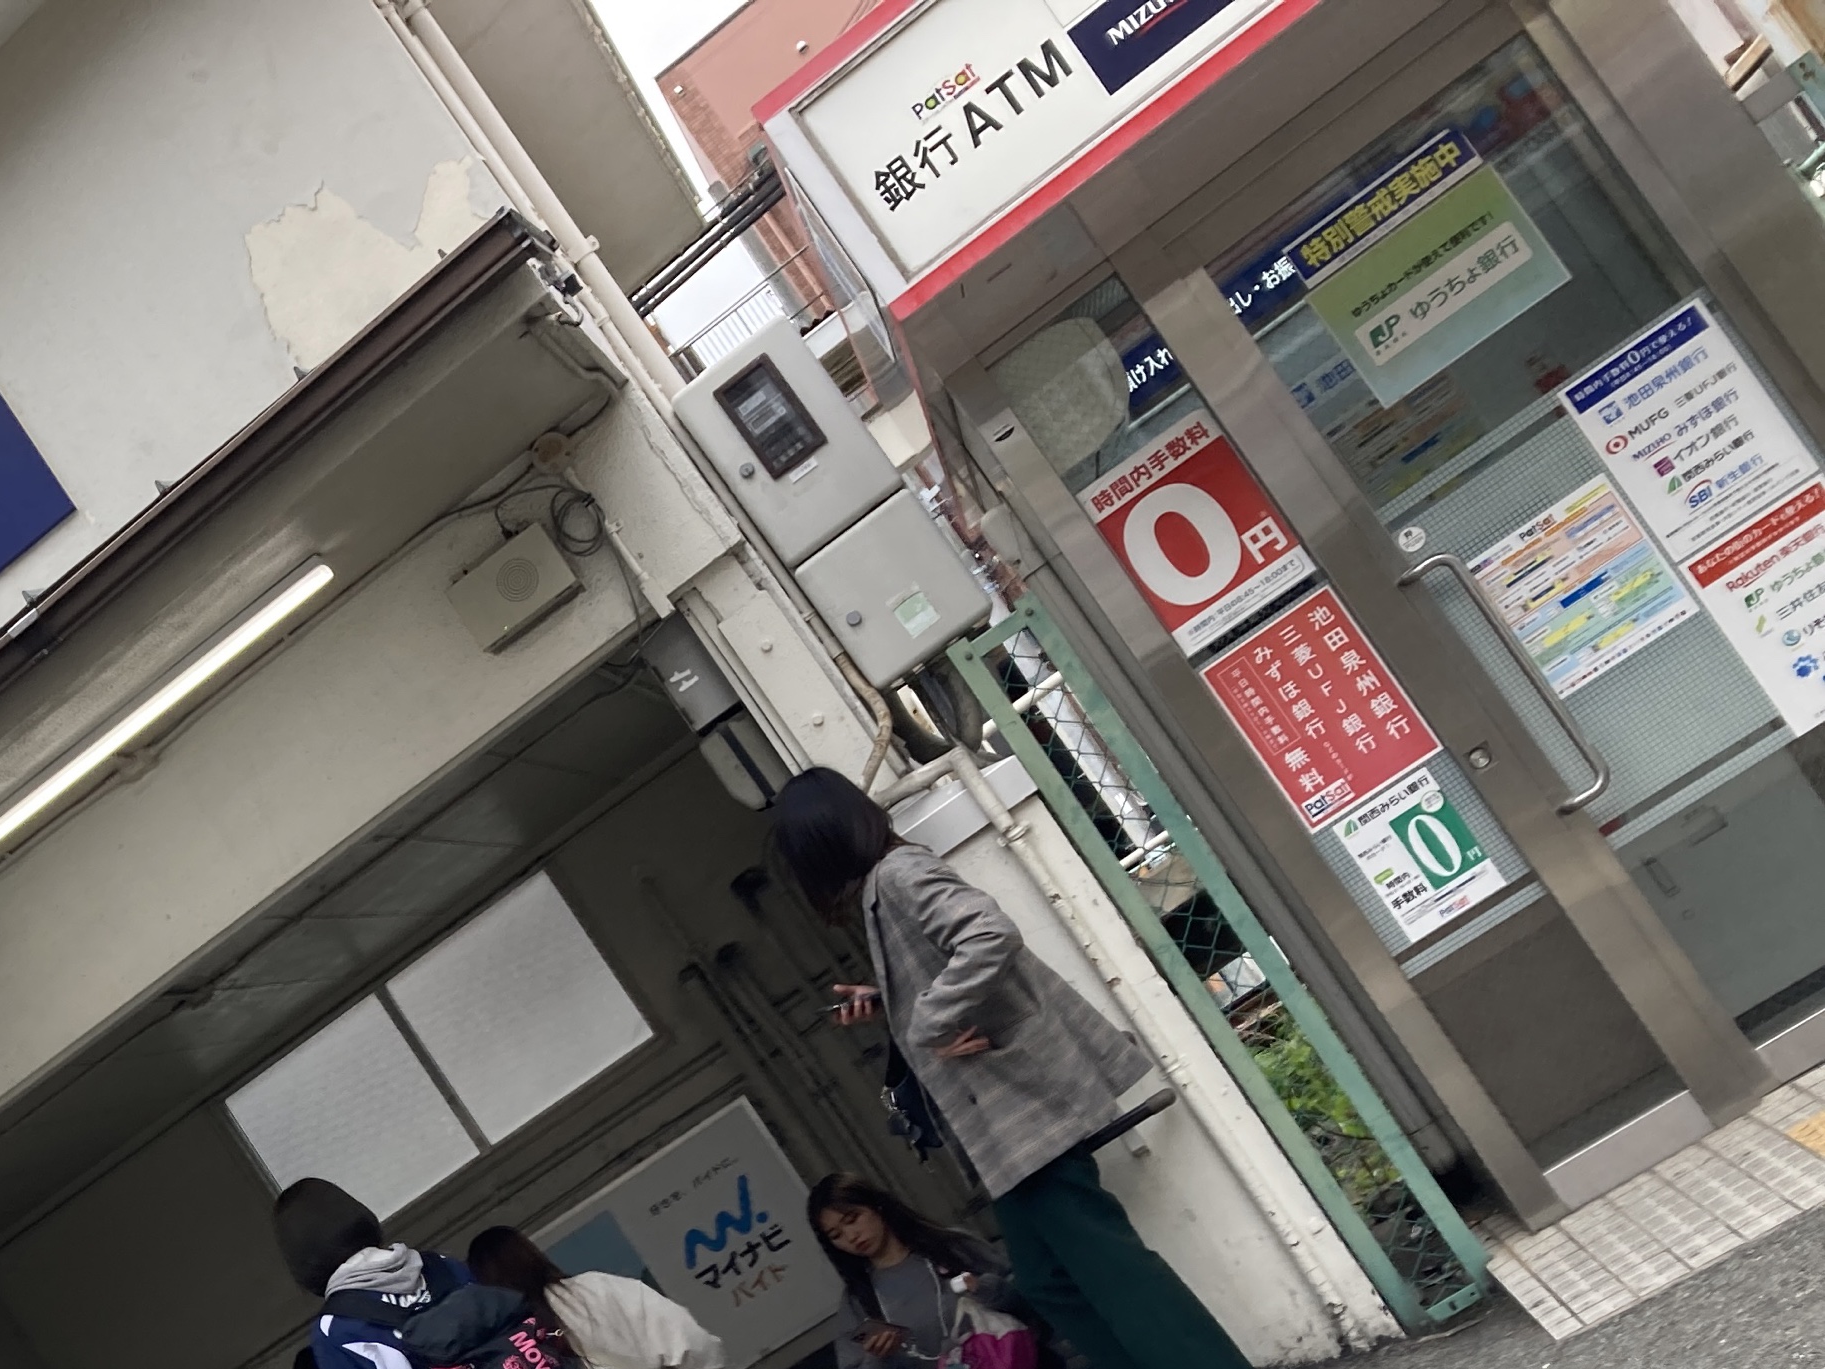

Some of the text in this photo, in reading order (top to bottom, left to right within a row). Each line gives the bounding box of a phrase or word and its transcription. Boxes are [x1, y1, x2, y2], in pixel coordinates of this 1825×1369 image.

[1106, 0, 1174, 45] MIZU
[912, 62, 979, 120] PatSat
[1299, 137, 1466, 269] 特別警戒実施中
[1408, 233, 1521, 322] ゆうちょ銀行
[1622, 346, 1709, 410] 池田泉州銀行
[1627, 362, 1738, 439] MUFG 三菱UFJ銀行
[1671, 414, 1740, 463] イオン銀行
[1673, 387, 1740, 437] みずほ銀行
[1091, 421, 1211, 514] 時間内手数料
[1681, 429, 1756, 482] 関西みらい銀行
[1686, 485, 1713, 508] SBI
[1714, 452, 1764, 489] 新生銀行
[1518, 512, 1555, 541] PatSat
[1726, 553, 1781, 592] Rakuten
[1250, 641, 1328, 741] みずほ銀行
[1277, 623, 1379, 756] 三菱UFJ銀行
[1307, 603, 1413, 741] 池田泉州銀行
[1230, 667, 1289, 745] 平日時間内手数料
[1282, 743, 1326, 795] 無料
[1304, 778, 1350, 814] PatSat
[1357, 774, 1430, 826] 関西みらい銀行
[1385, 870, 1410, 890] 時間内
[1390, 881, 1428, 911] 手数料
[693, 1222, 792, 1289] マイナビ
[728, 1264, 786, 1307] バイト
